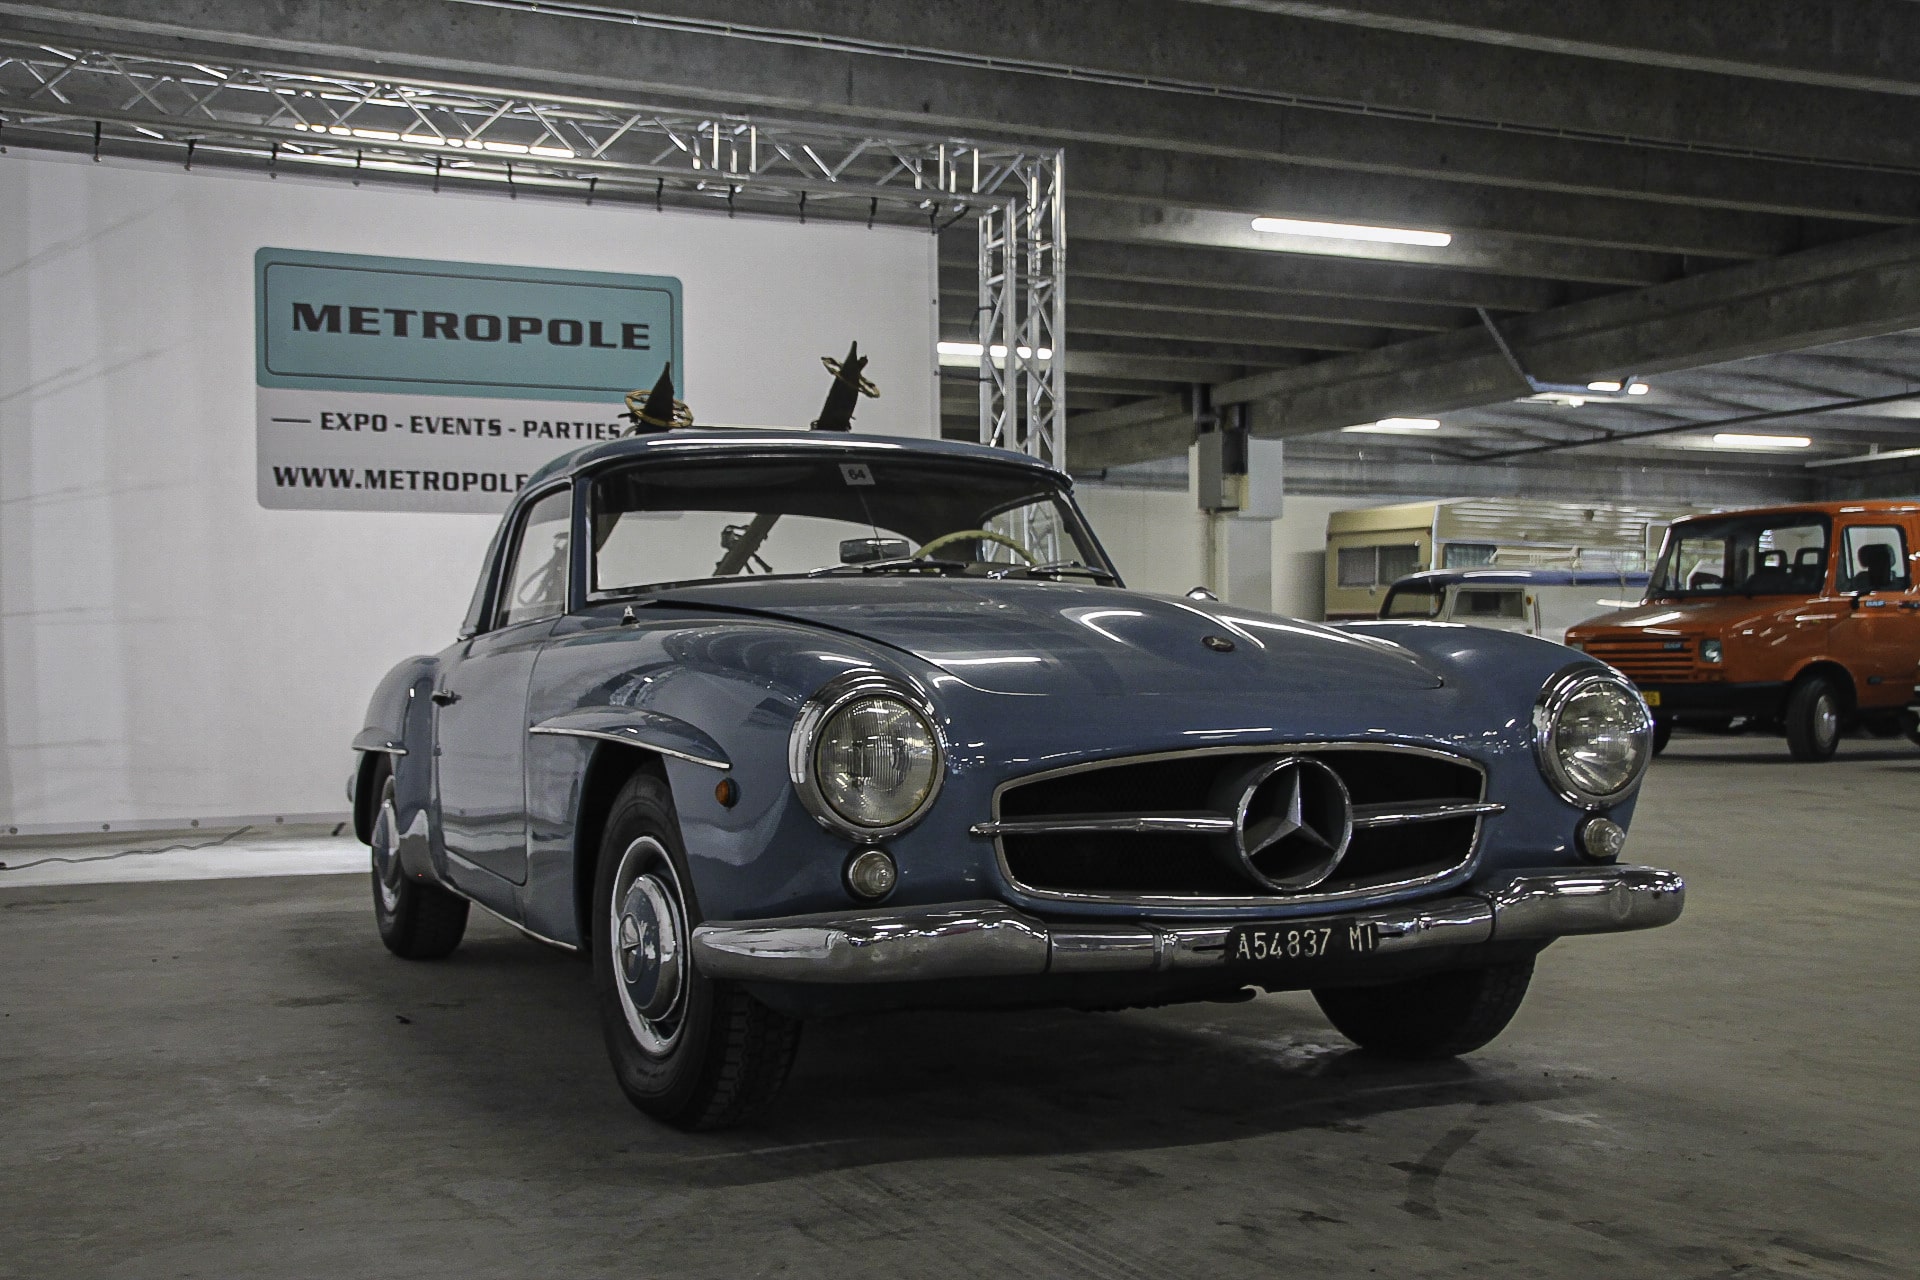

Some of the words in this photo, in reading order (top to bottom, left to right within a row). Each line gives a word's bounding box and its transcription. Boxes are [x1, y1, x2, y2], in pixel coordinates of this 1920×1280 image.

[292, 302, 651, 351] METROPOLE
[320, 411, 388, 433] EXPO
[410, 415, 502, 437] EVENTS
[522, 419, 621, 441] PARTIES
[847, 469, 866, 480] 64
[1235, 927, 1332, 960] A54837
[1349, 924, 1373, 952] MI
